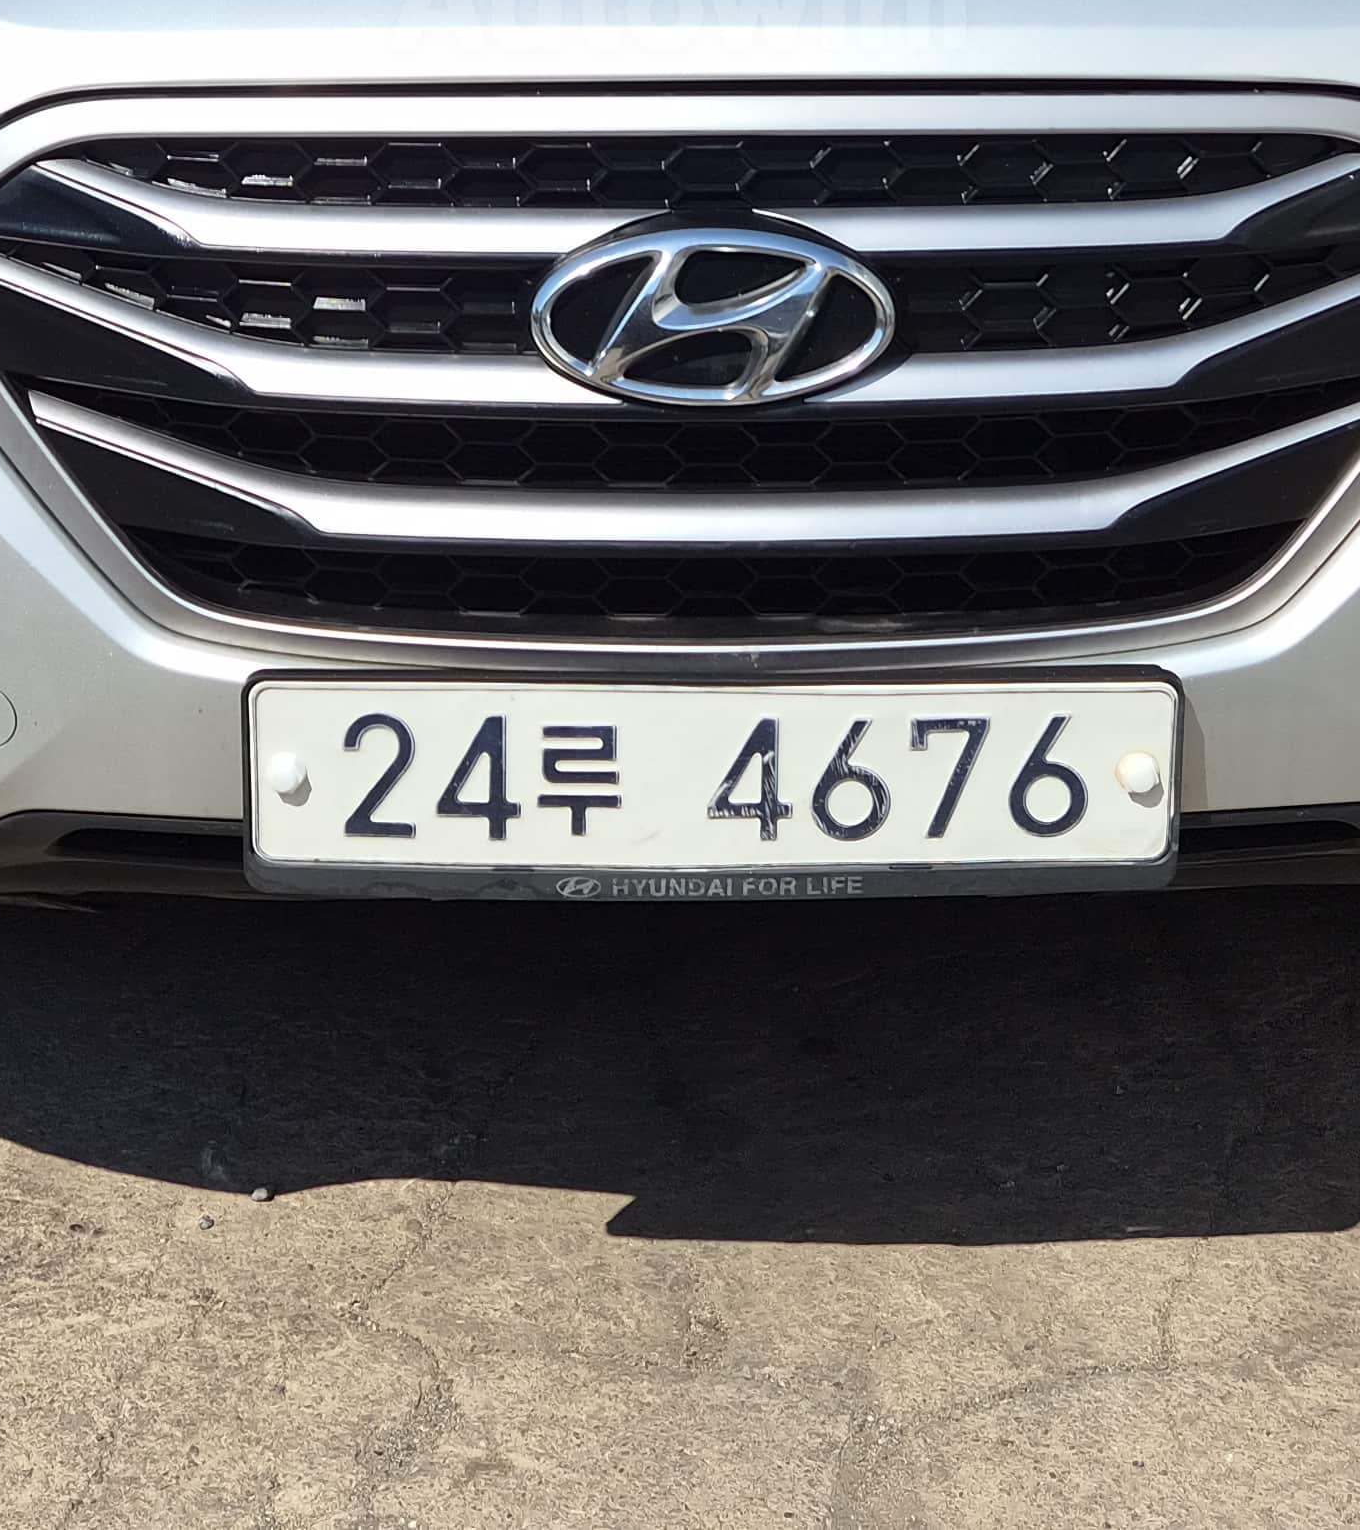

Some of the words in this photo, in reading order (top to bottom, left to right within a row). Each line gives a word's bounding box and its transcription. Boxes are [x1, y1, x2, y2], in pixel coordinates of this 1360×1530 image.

[343, 713, 623, 841] 24루
[706, 713, 1089, 842] 4676
[611, 876, 733, 897] HYUNDAI
[742, 876, 797, 896] FOR
[806, 875, 864, 895] LIFE
